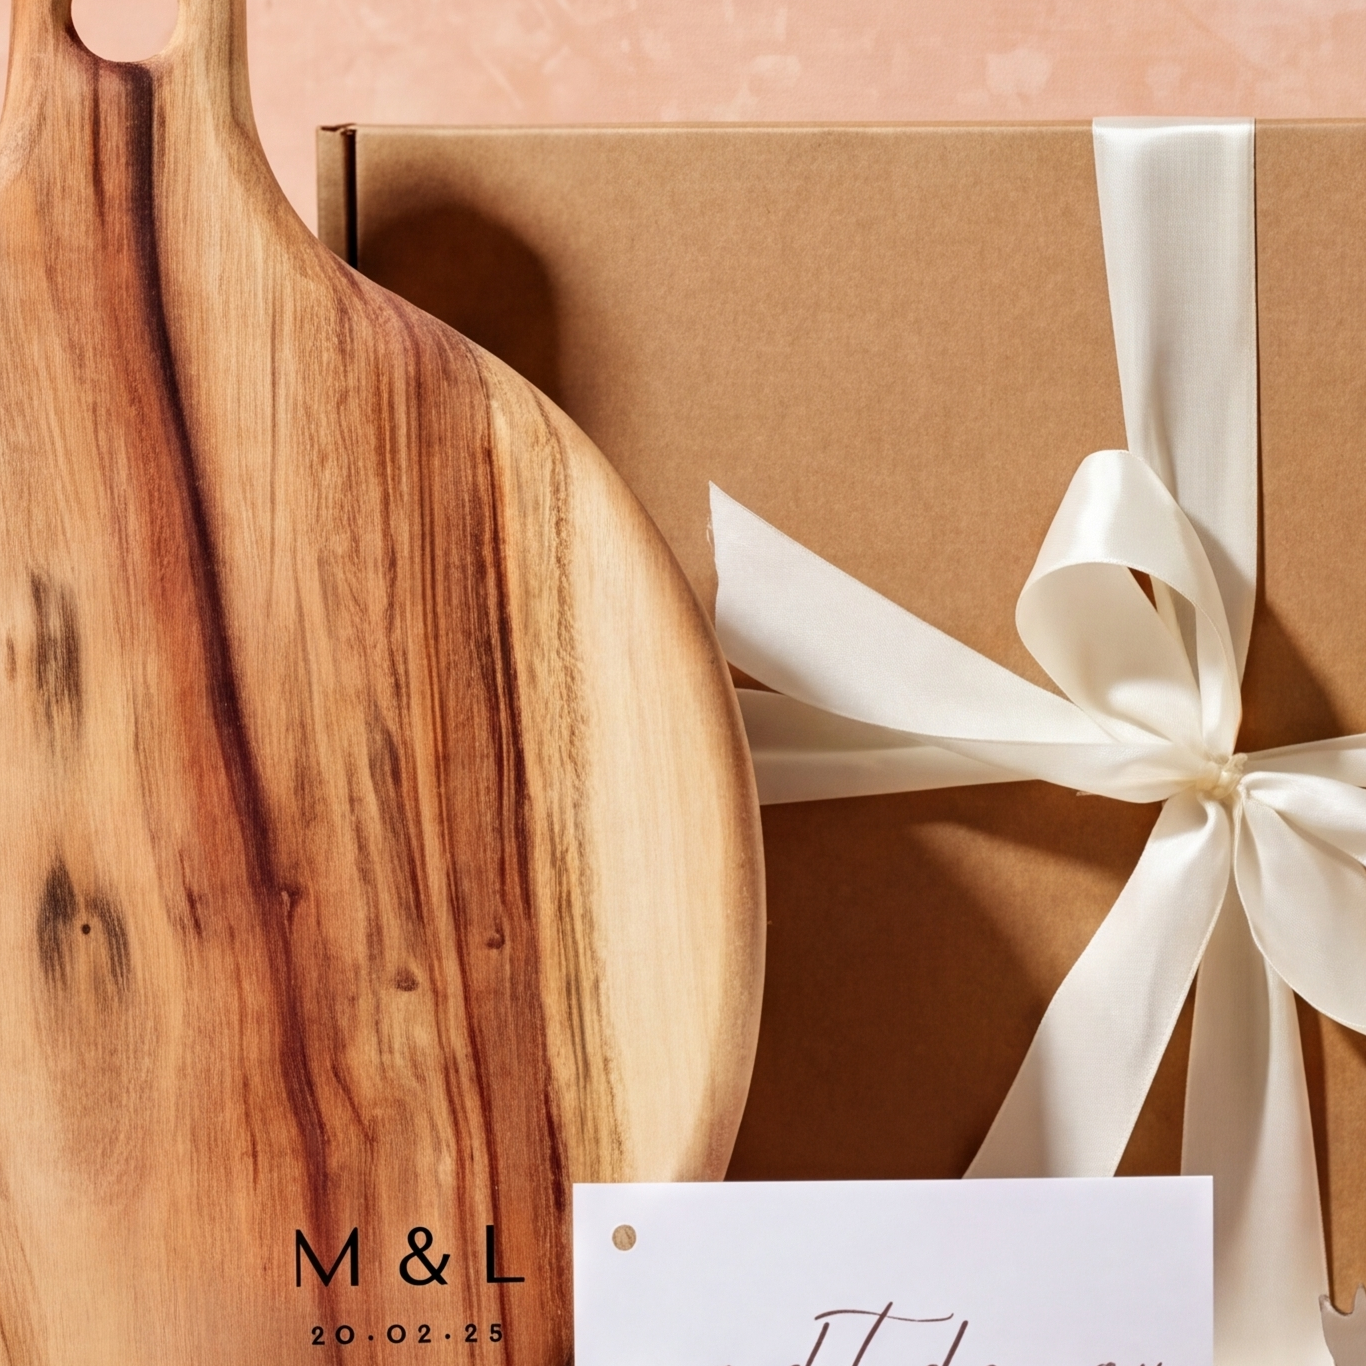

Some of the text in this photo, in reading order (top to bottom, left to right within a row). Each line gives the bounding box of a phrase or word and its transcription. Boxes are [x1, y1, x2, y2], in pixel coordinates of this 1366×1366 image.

[295, 1224, 525, 1287] M & L
[311, 1323, 503, 1346] 20.02.25
